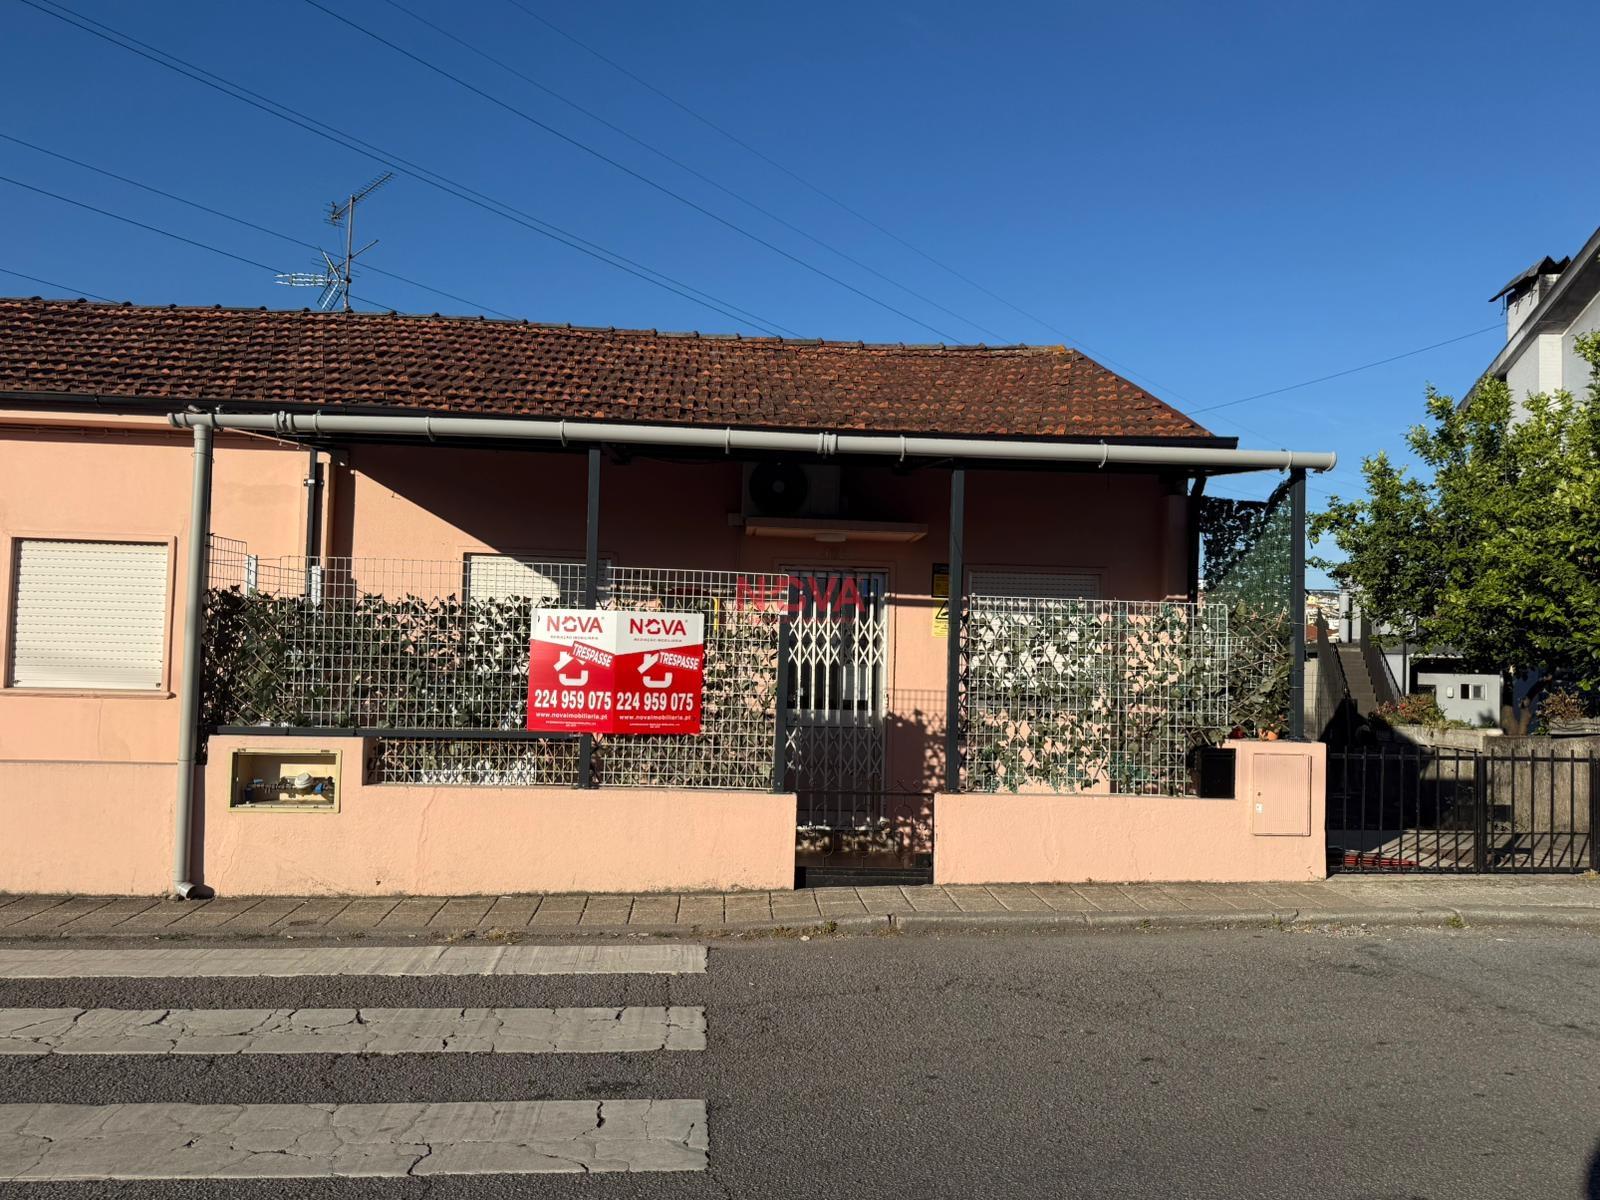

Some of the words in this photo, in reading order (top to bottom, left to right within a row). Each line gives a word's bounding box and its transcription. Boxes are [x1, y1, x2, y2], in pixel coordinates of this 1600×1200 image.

[547, 615, 603, 633] NOVA
[629, 618, 687, 636] NOVA
[572, 643, 613, 667] TRESPASSE
[659, 651, 700, 671] TRESPASSE
[534, 689, 557, 708] 224
[561, 690, 585, 709] 959
[588, 690, 612, 710] 075
[616, 692, 640, 711] 224
[644, 692, 667, 711] 959
[670, 693, 694, 712] 075
